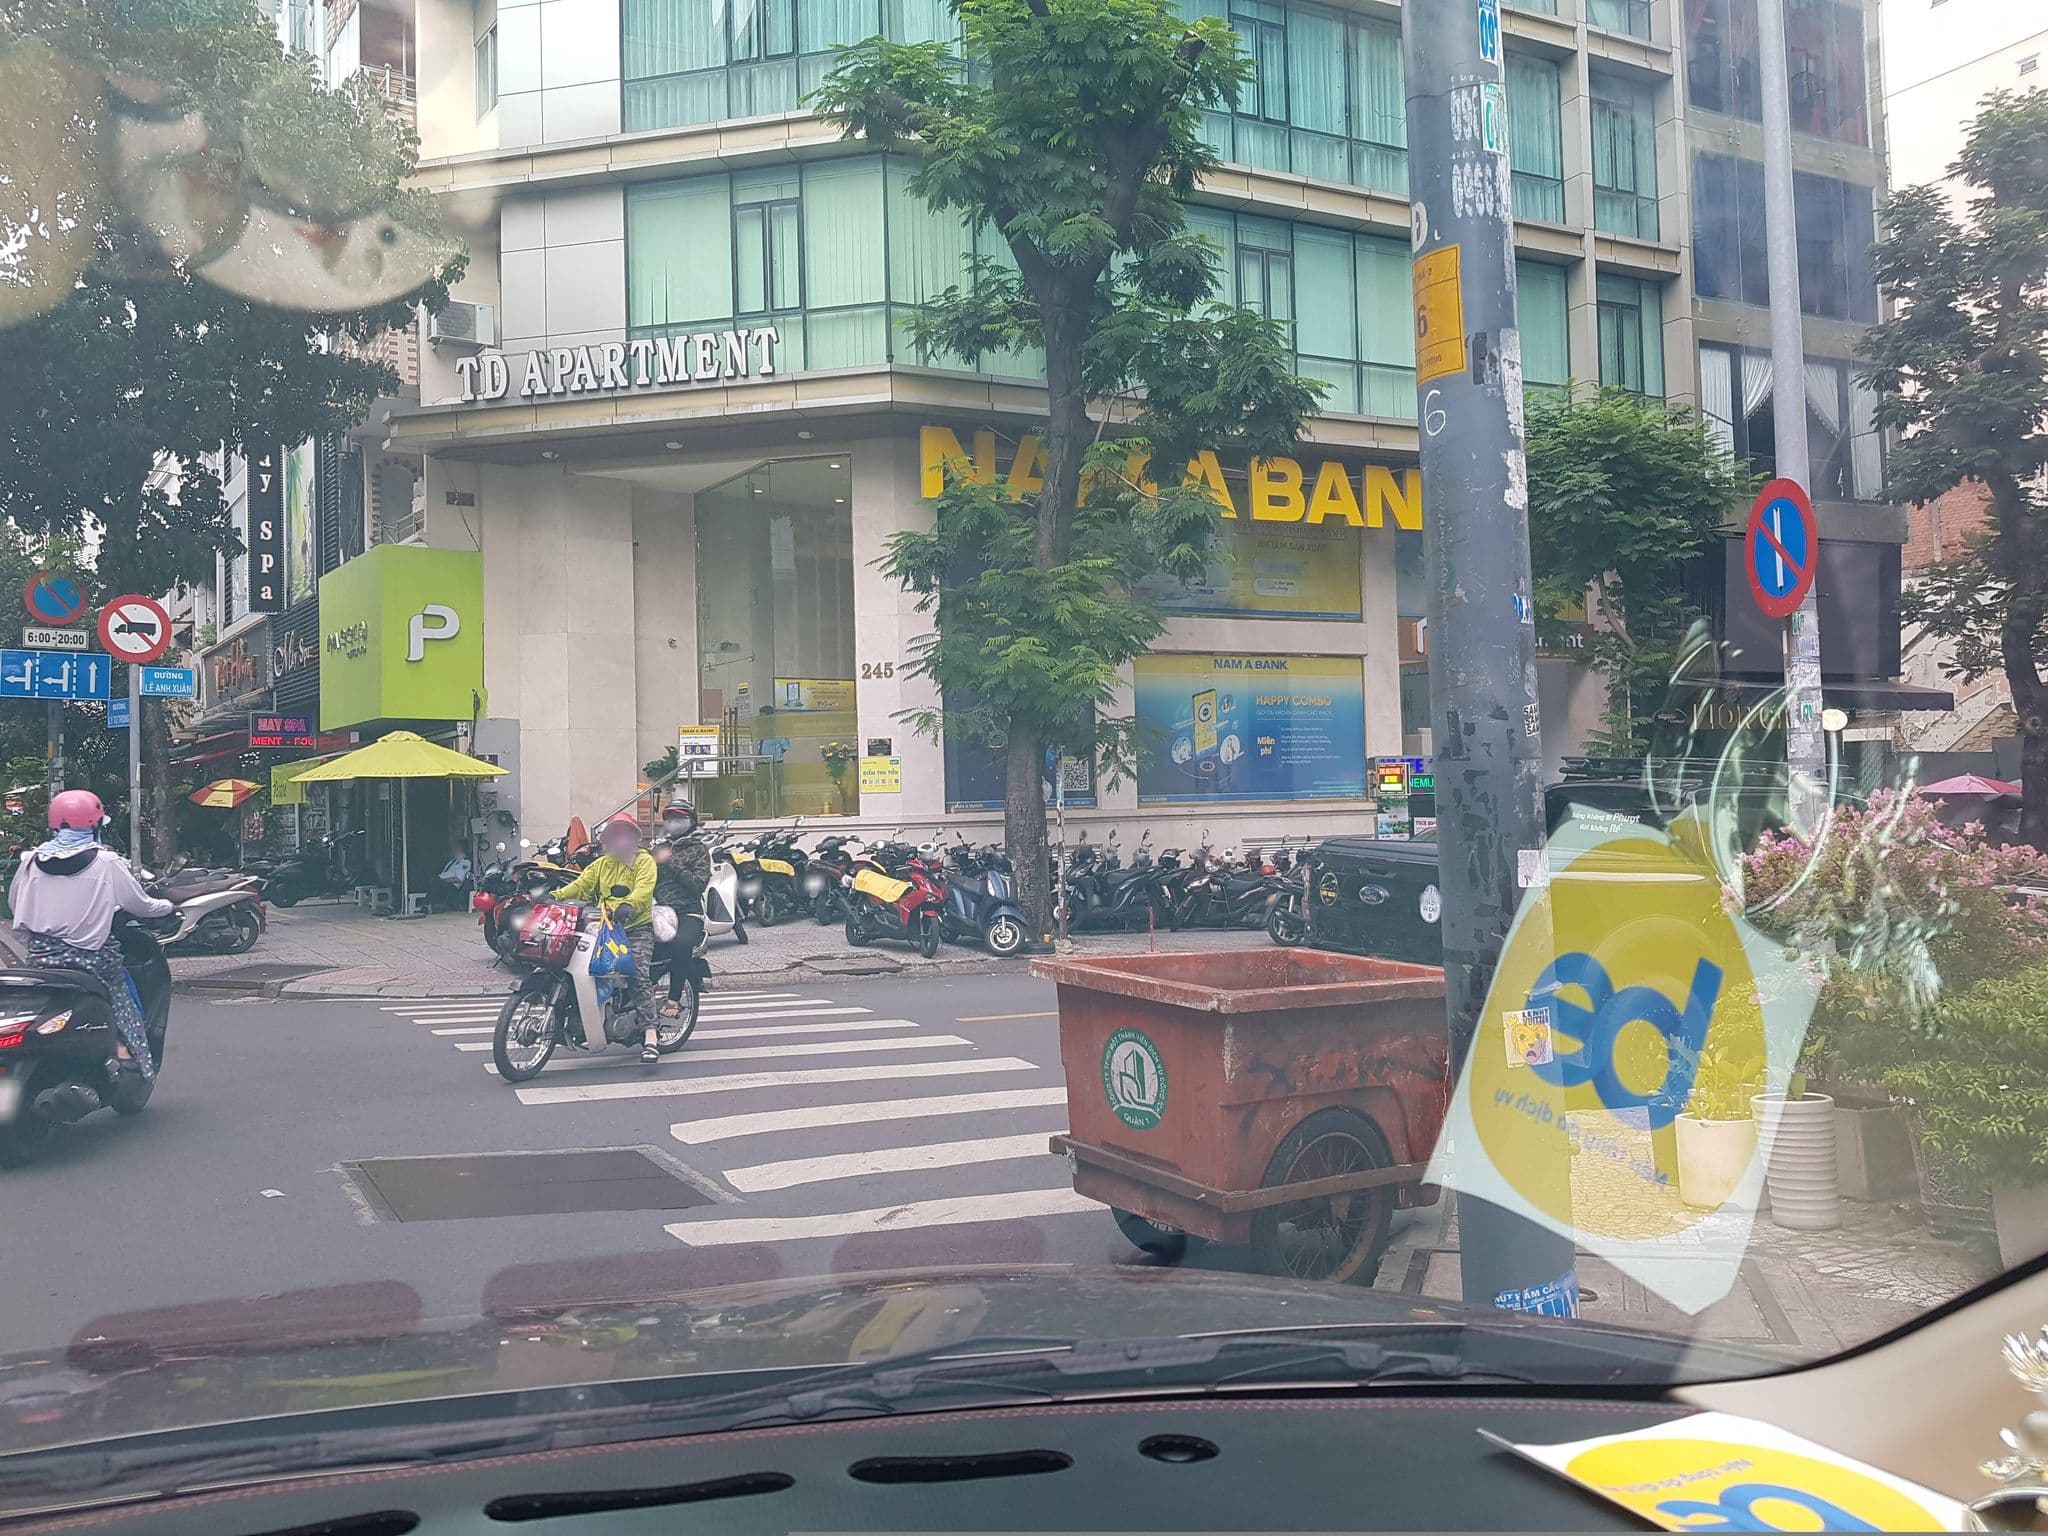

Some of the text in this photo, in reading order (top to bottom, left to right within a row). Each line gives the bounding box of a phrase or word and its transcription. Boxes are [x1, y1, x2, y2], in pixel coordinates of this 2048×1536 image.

[454, 326, 778, 401] TD APARTMENT
[1424, 389, 1446, 437] 6
[919, 425, 1158, 508] NA
[1249, 456, 1424, 531] BAN
[405, 604, 461, 662] P
[861, 662, 894, 680] 245
[1213, 659, 1288, 670] NAM A BANK
[156, 683, 171, 692] ANH
[172, 682, 192, 693] XUÂN
[1256, 696, 1333, 706] HAPPY COMBO
